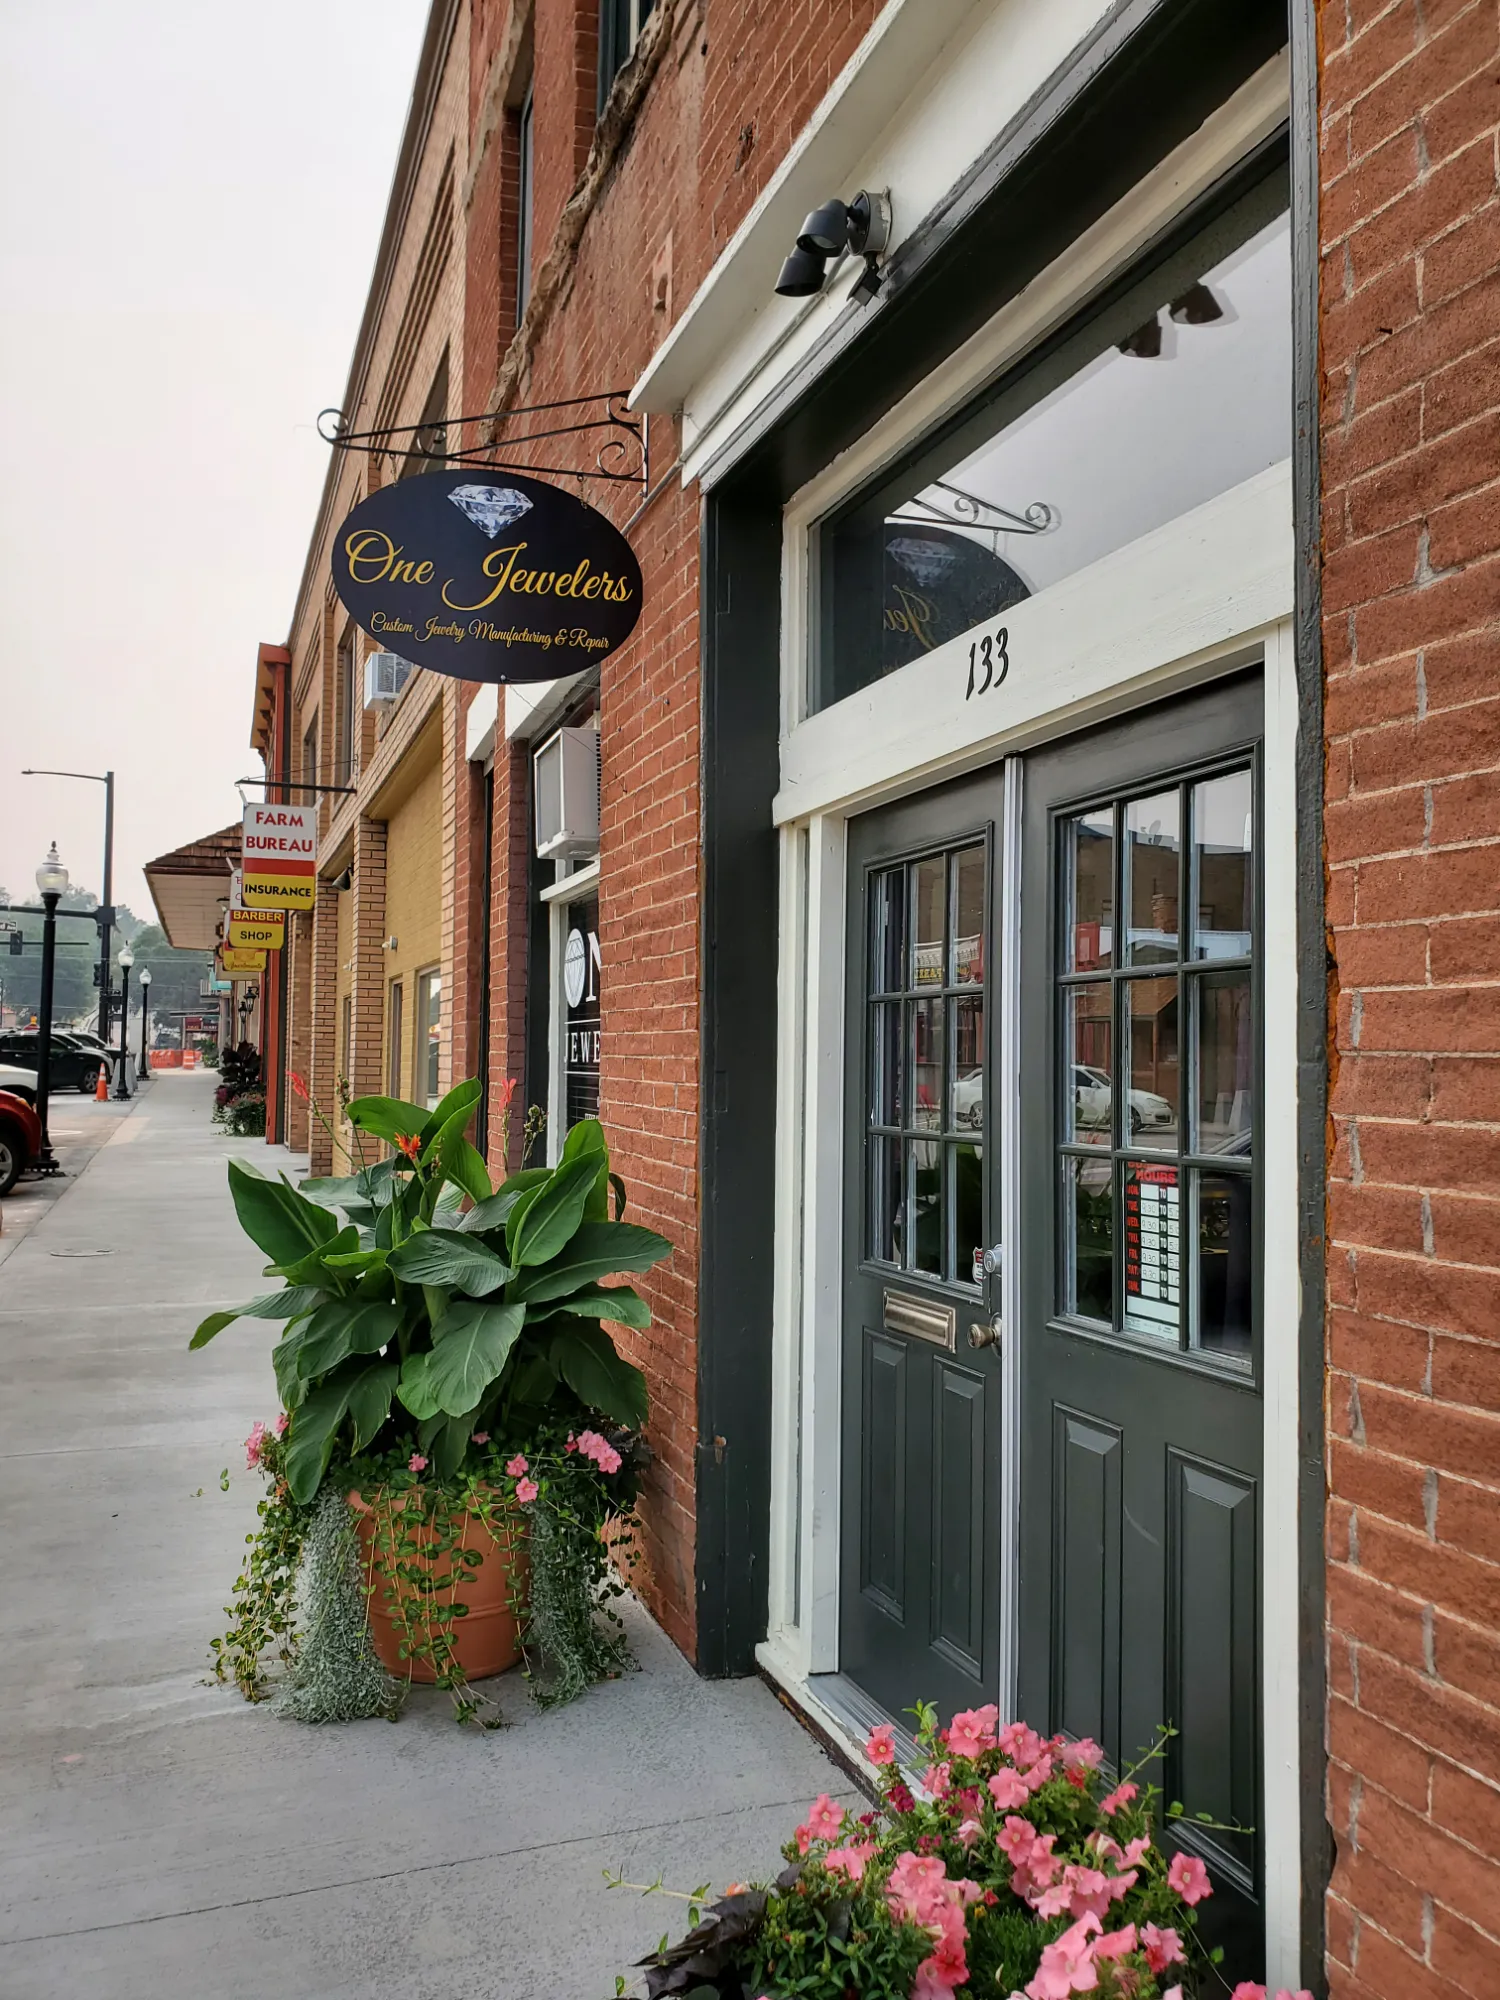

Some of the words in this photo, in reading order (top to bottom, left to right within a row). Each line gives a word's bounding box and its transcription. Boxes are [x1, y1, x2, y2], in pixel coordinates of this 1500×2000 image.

[345, 529, 435, 584] One
[441, 542, 633, 611] Jewelers
[370, 610, 414, 633] Custom
[414, 616, 466, 643] Jewelry
[468, 618, 552, 650] Manufacturing
[554, 628, 568, 645] &
[568, 628, 610, 652] Repair
[965, 627, 1009, 701] 133
[256, 811, 304, 827] FARM
[246, 836, 313, 853] BUREAU
[244, 884, 312, 897] INSURANCE
[233, 910, 282, 922] BARBER
[240, 930, 273, 941] SHOP
[1135, 1169, 1177, 1184] HOURS
[1160, 1188, 1167, 1199] TO
[1160, 1204, 1167, 1215] TO
[1160, 1221, 1167, 1232] TO
[1160, 1237, 1167, 1248] TO
[1160, 1254, 1168, 1265] TO
[1160, 1271, 1168, 1281] TO
[1160, 1287, 1168, 1298] TO
